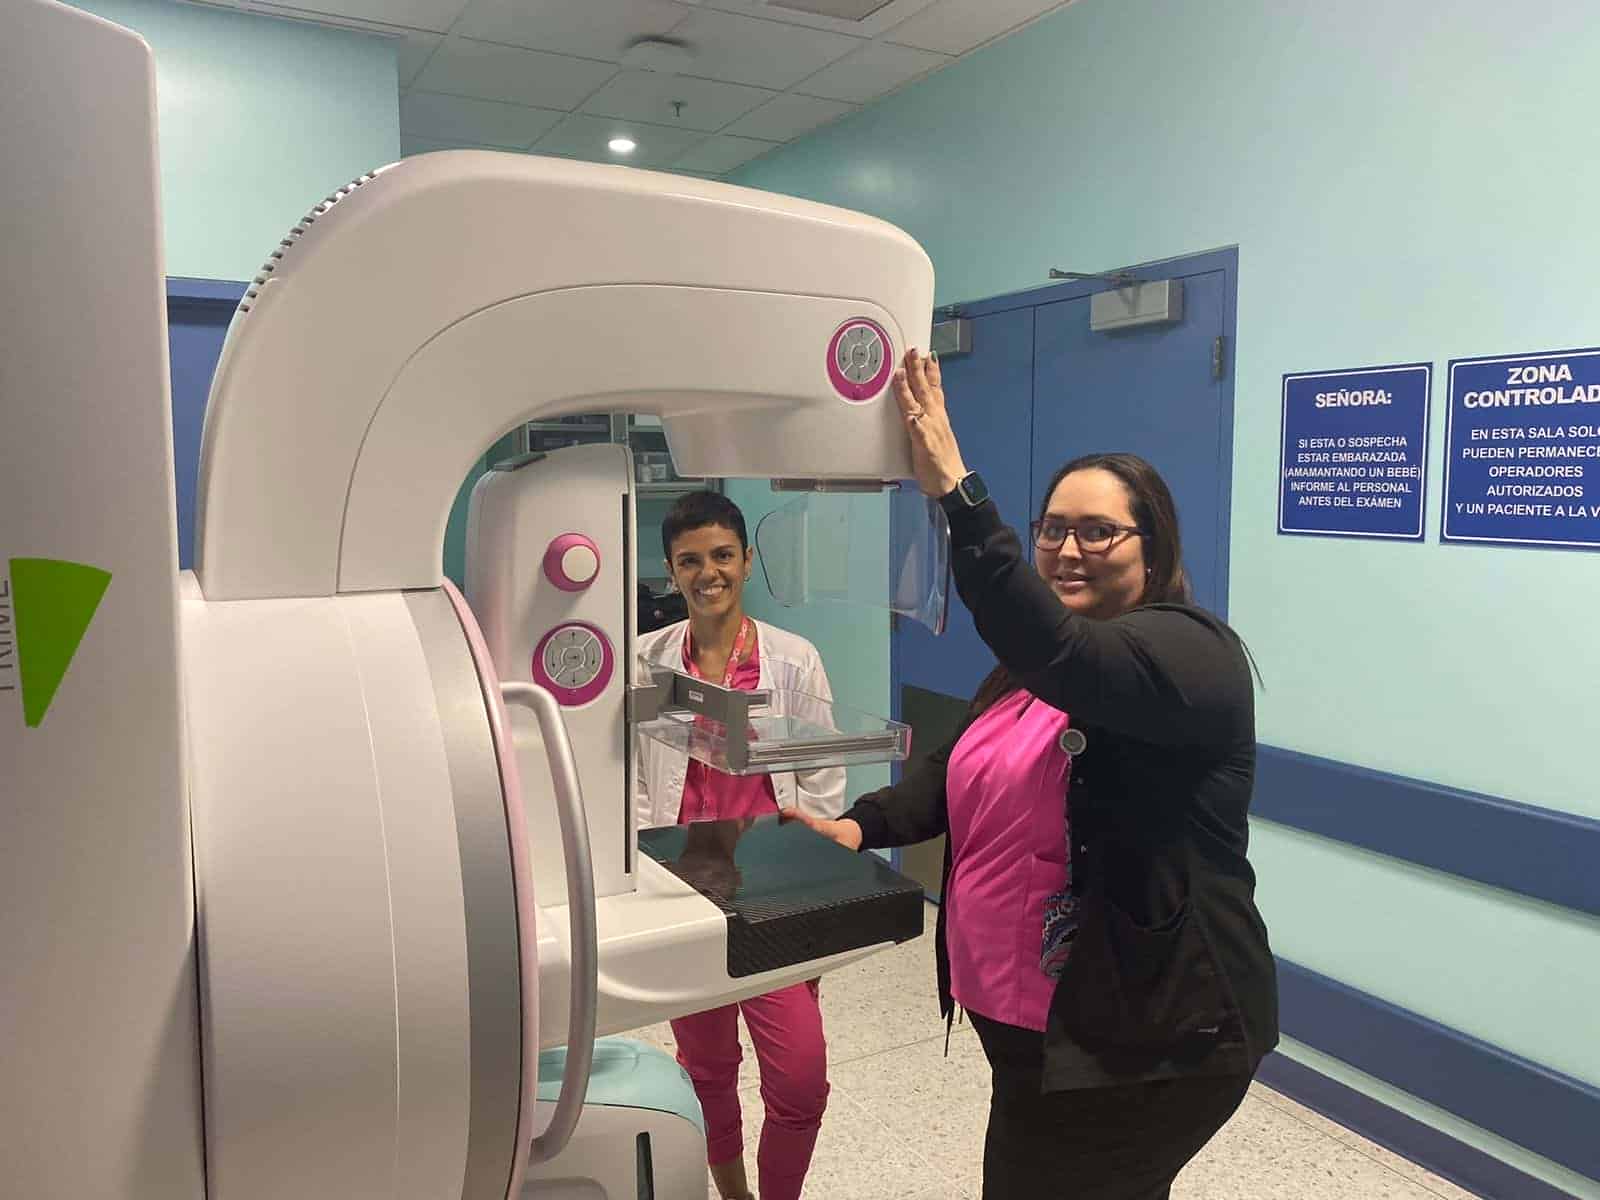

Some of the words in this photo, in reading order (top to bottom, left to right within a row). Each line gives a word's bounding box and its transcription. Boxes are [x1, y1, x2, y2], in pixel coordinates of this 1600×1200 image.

[1507, 364, 1573, 385] ZONA
[1315, 388, 1392, 408] SEÑORA:
[1463, 384, 1600, 409] CONTROLAD
[1471, 428, 1489, 440] EN
[1492, 427, 1525, 440] ESTA
[1527, 426, 1565, 439] SALA
[1298, 438, 1308, 449] SI
[1310, 438, 1336, 449] ESTA
[1337, 438, 1346, 448] O
[1348, 436, 1408, 448] SOSPECHA
[1297, 452, 1330, 463] ESTAR
[1332, 451, 1407, 463] EMBARAZADA
[1462, 447, 1515, 459] PUEDEN
[1284, 467, 1366, 478] (AMAMANTANDO
[1369, 467, 1384, 477] UN
[1386, 464, 1421, 480] BEBÉ)
[1488, 465, 1584, 478] OPERADORES
[1290, 481, 1335, 492] INFORME
[1337, 482, 1351, 492] AL
[1353, 482, 1412, 493] PERSONAL
[1486, 484, 1584, 497] AUTORIZADOS
[1298, 496, 1332, 507] ANTES
[1334, 496, 1354, 507] DEL
[1356, 495, 1401, 508] EXÁMEN
[1456, 503, 1464, 514] Y
[1466, 503, 1484, 514] UN
[1487, 504, 1552, 516] PACIENTE
[1554, 505, 1565, 516] A
[1568, 505, 1587, 517] LA
